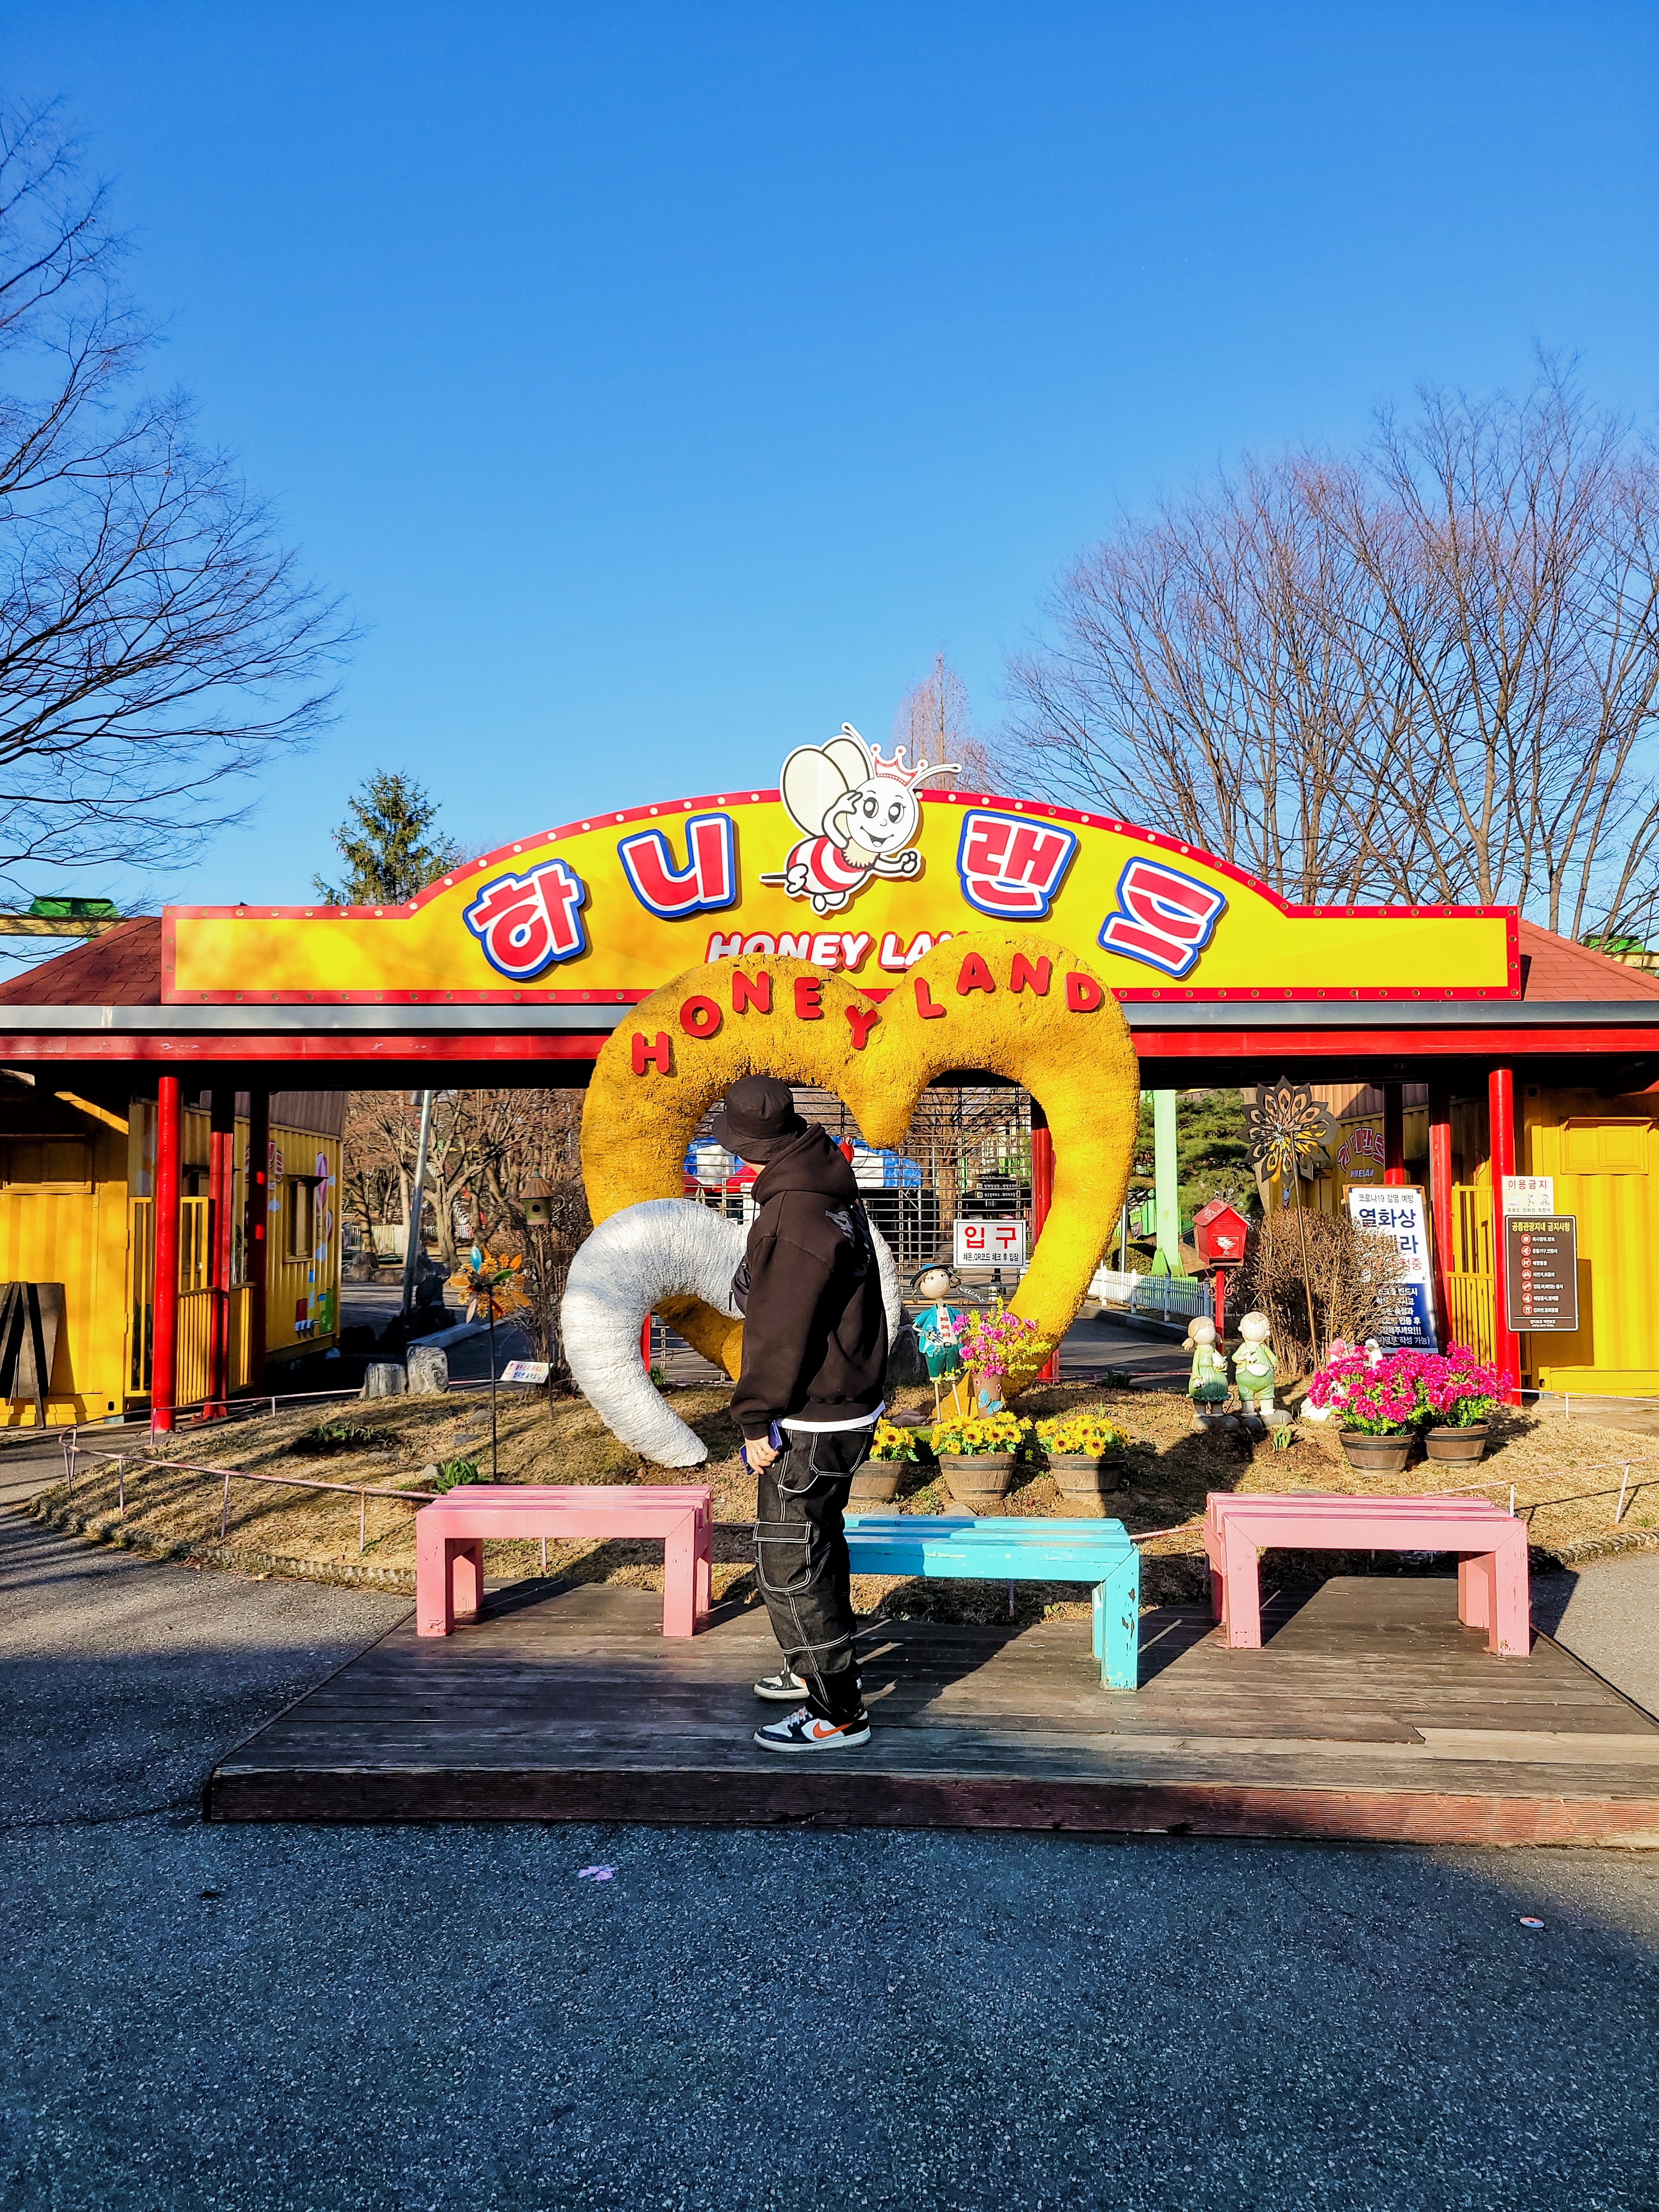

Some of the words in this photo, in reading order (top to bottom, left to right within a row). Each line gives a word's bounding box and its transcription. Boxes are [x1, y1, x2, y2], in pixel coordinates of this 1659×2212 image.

[704, 932, 872, 969] HONEY
[631, 971, 878, 1075] HONEY
[913, 952, 1102, 1019] LAND
[1508, 1180, 1547, 1189] 이용금지
[1358, 1194, 1385, 1203] 코로나19
[1386, 1194, 1399, 1203] 감염
[1401, 1194, 1414, 1203] 예방
[1359, 1209, 1416, 1228] 열화상
[1547, 1222, 1570, 1232] 금지사항
[992, 1252, 1001, 1261] 체크
[1002, 1252, 1008, 1261] 후
[1009, 1252, 1019, 1261] 입장
[958, 1287, 985, 1303] WELCOME
[1397, 1288, 1418, 1296] 반드시
[1399, 1317, 1412, 1325] 인증
[1413, 1317, 1421, 1325] 후
[1400, 1336, 1413, 1345] 작성
[1414, 1336, 1430, 1346] 가능)
